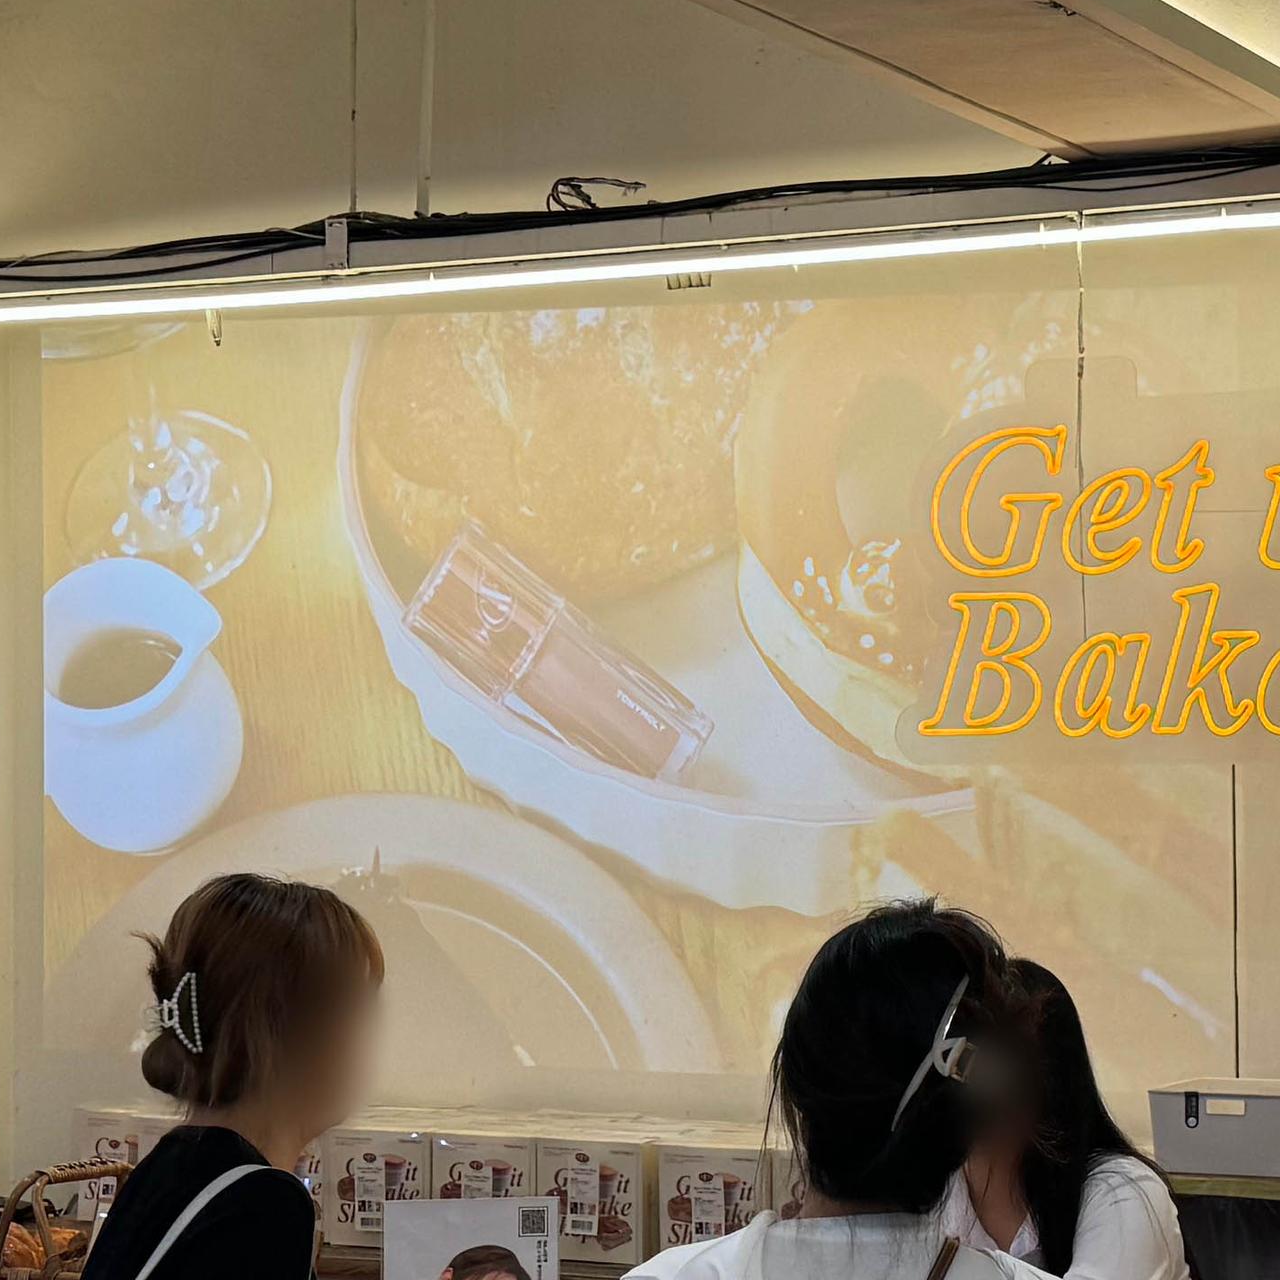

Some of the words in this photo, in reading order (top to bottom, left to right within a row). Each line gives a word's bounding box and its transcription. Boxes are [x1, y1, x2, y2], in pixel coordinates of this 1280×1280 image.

[930, 424, 1215, 578] Get
[405, 1161, 419, 1182] it
[510, 1167, 524, 1188] it
[385, 1183, 420, 1201] ake
[616, 1174, 630, 1195] it
[739, 1181, 754, 1202] it
[599, 1195, 632, 1217] ake
